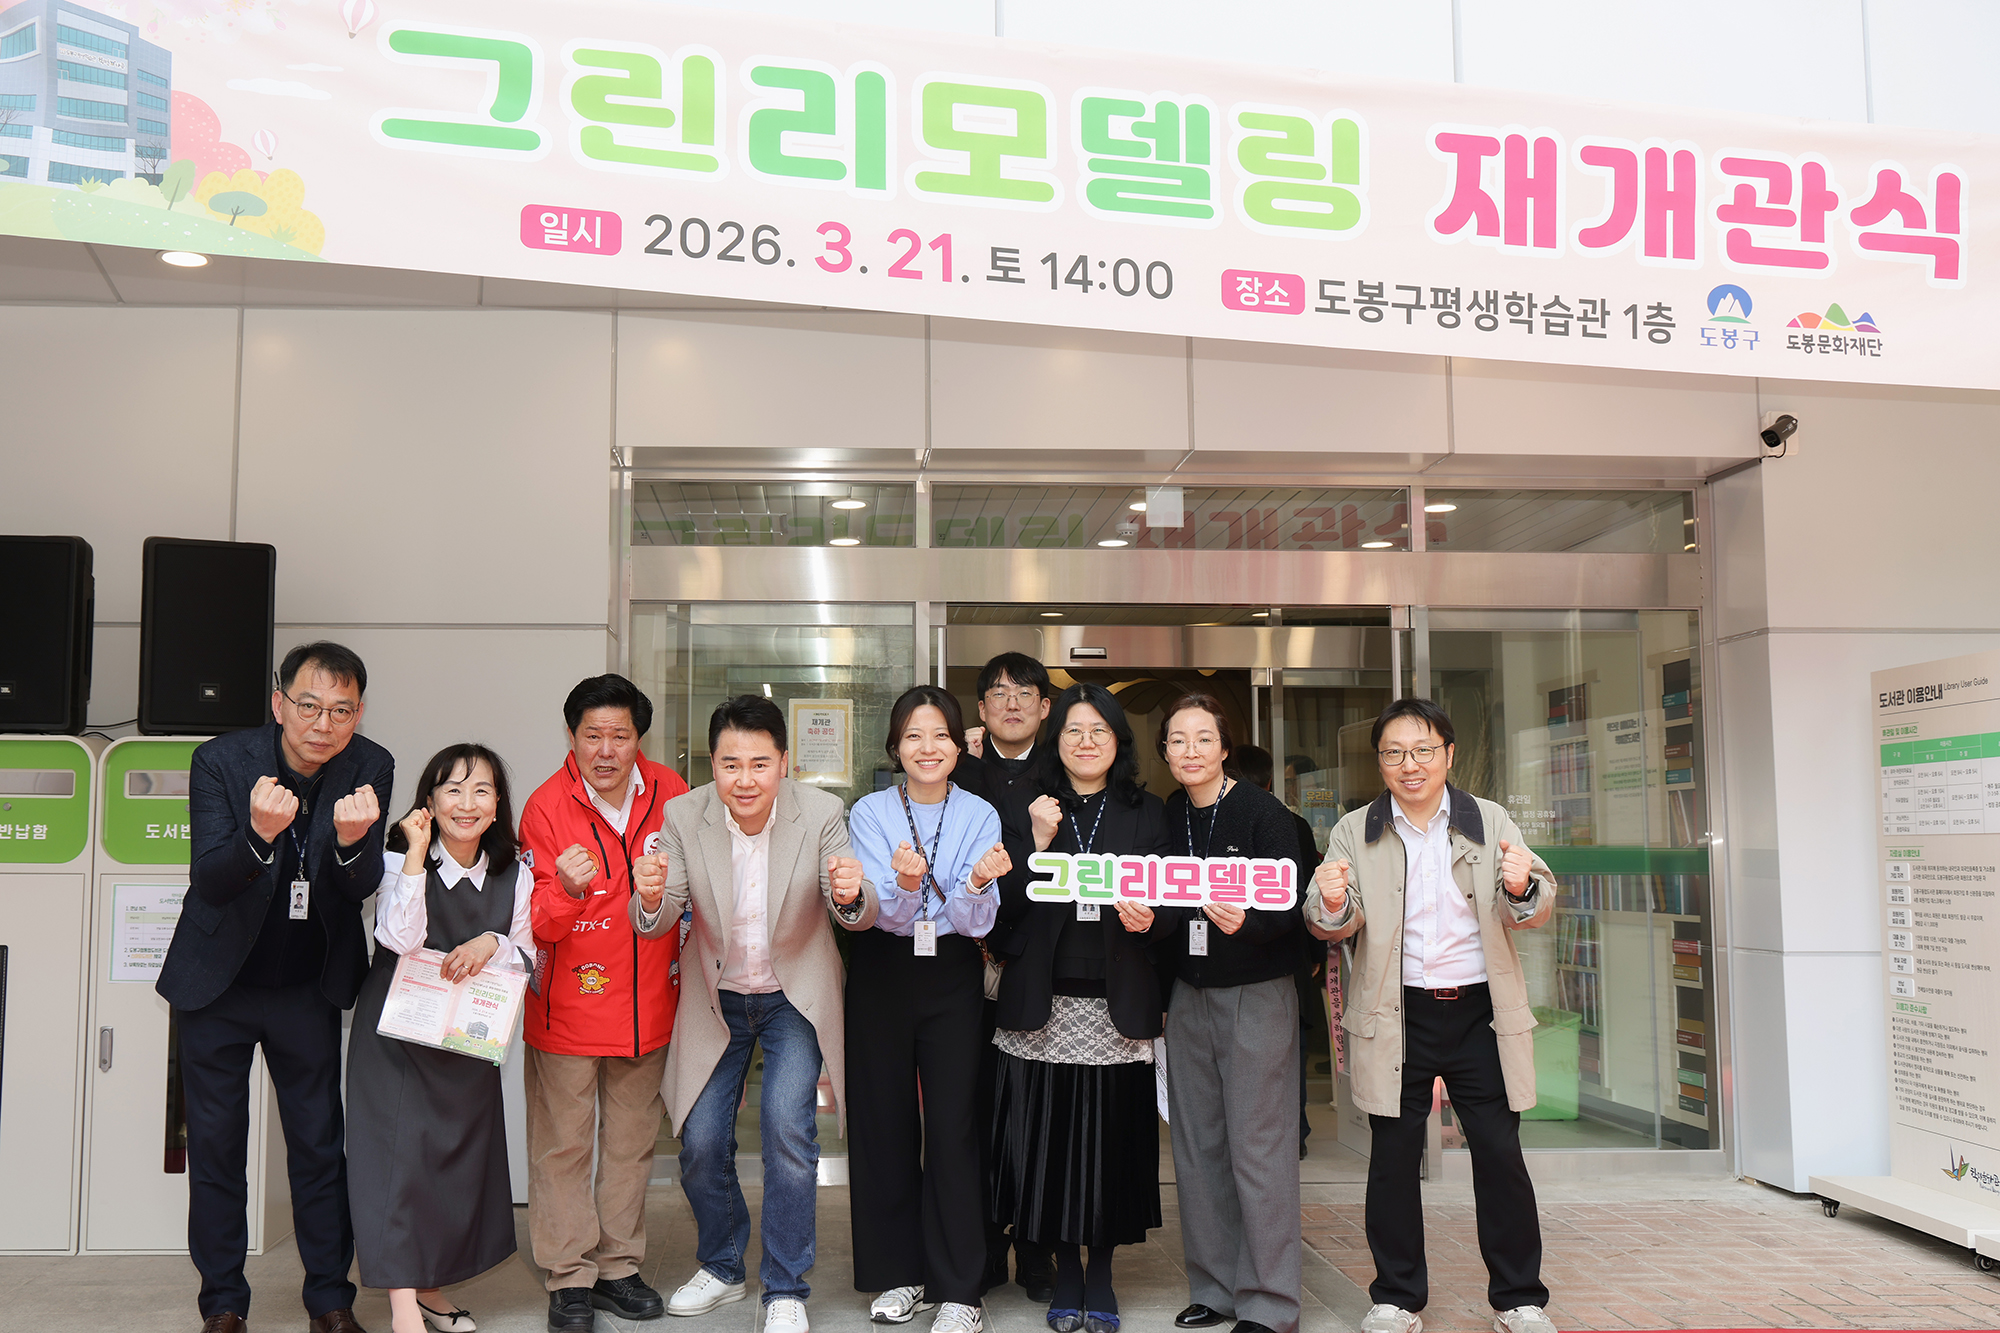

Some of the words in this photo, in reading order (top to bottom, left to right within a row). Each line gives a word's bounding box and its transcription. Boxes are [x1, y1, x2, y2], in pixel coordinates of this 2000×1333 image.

[382, 29, 1360, 231] 그린리모델링
[1434, 132, 1961, 280] 재개관식
[539, 211, 602, 248] 일시
[644, 213, 796, 268] 2026.
[986, 246, 1026, 284] 토
[1040, 252, 1173, 299] 14:00
[1236, 276, 1293, 308] 장소
[1315, 279, 1611, 340] 도봉구평생학습관
[1623, 302, 1676, 344] 1층
[1699, 328, 1760, 351] 도봉구
[1786, 334, 1883, 358] 도봉문화재단
[1880, 690, 1905, 708] 도서관
[1907, 683, 1944, 704] 이용안내
[1944, 683, 1960, 691] Library
[1974, 677, 1989, 686] Guide
[1306, 791, 1334, 801] 유리문
[1507, 795, 1530, 804] 휴관일
[1032, 860, 1291, 905] 그린리모델링
[572, 918, 612, 932] GTX-C
[468, 986, 508, 1004] 그린리모델링
[1328, 965, 1341, 1009] 재개관을
[472, 997, 499, 1010] 재개관식
